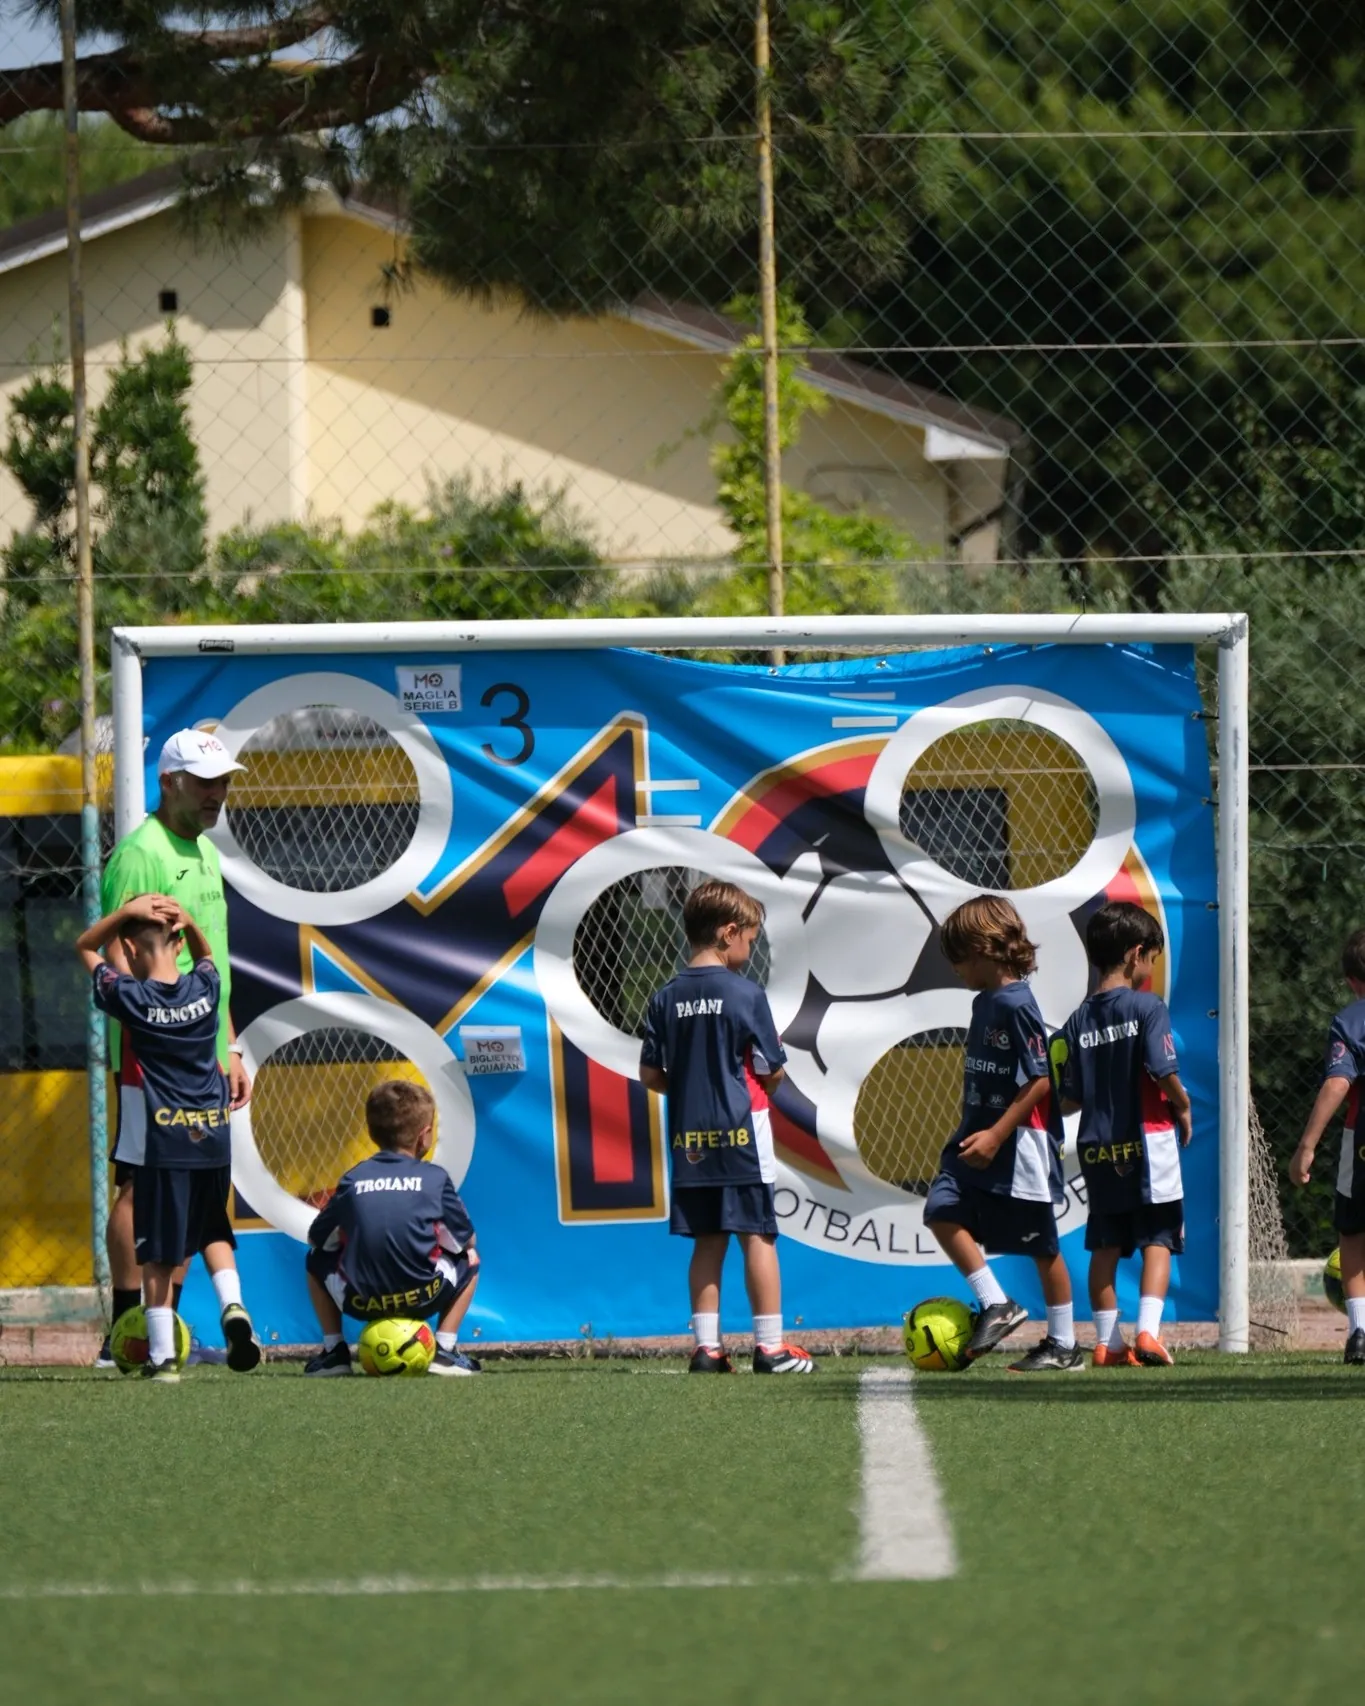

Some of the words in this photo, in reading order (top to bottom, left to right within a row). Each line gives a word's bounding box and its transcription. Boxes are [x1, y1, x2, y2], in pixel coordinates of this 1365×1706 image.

[403, 690, 457, 701] MAGLIA
[404, 700, 444, 711] SERIE
[449, 700, 458, 710] B
[480, 682, 535, 767] 3
[676, 998, 723, 1018] PAGANI
[470, 1054, 520, 1064] BIGLIETTO
[472, 1063, 519, 1074] AQUAFAN
[727, 1127, 750, 1147] 18
[354, 1176, 423, 1195] TROIANI
[351, 1288, 421, 1313] CAFFE'
